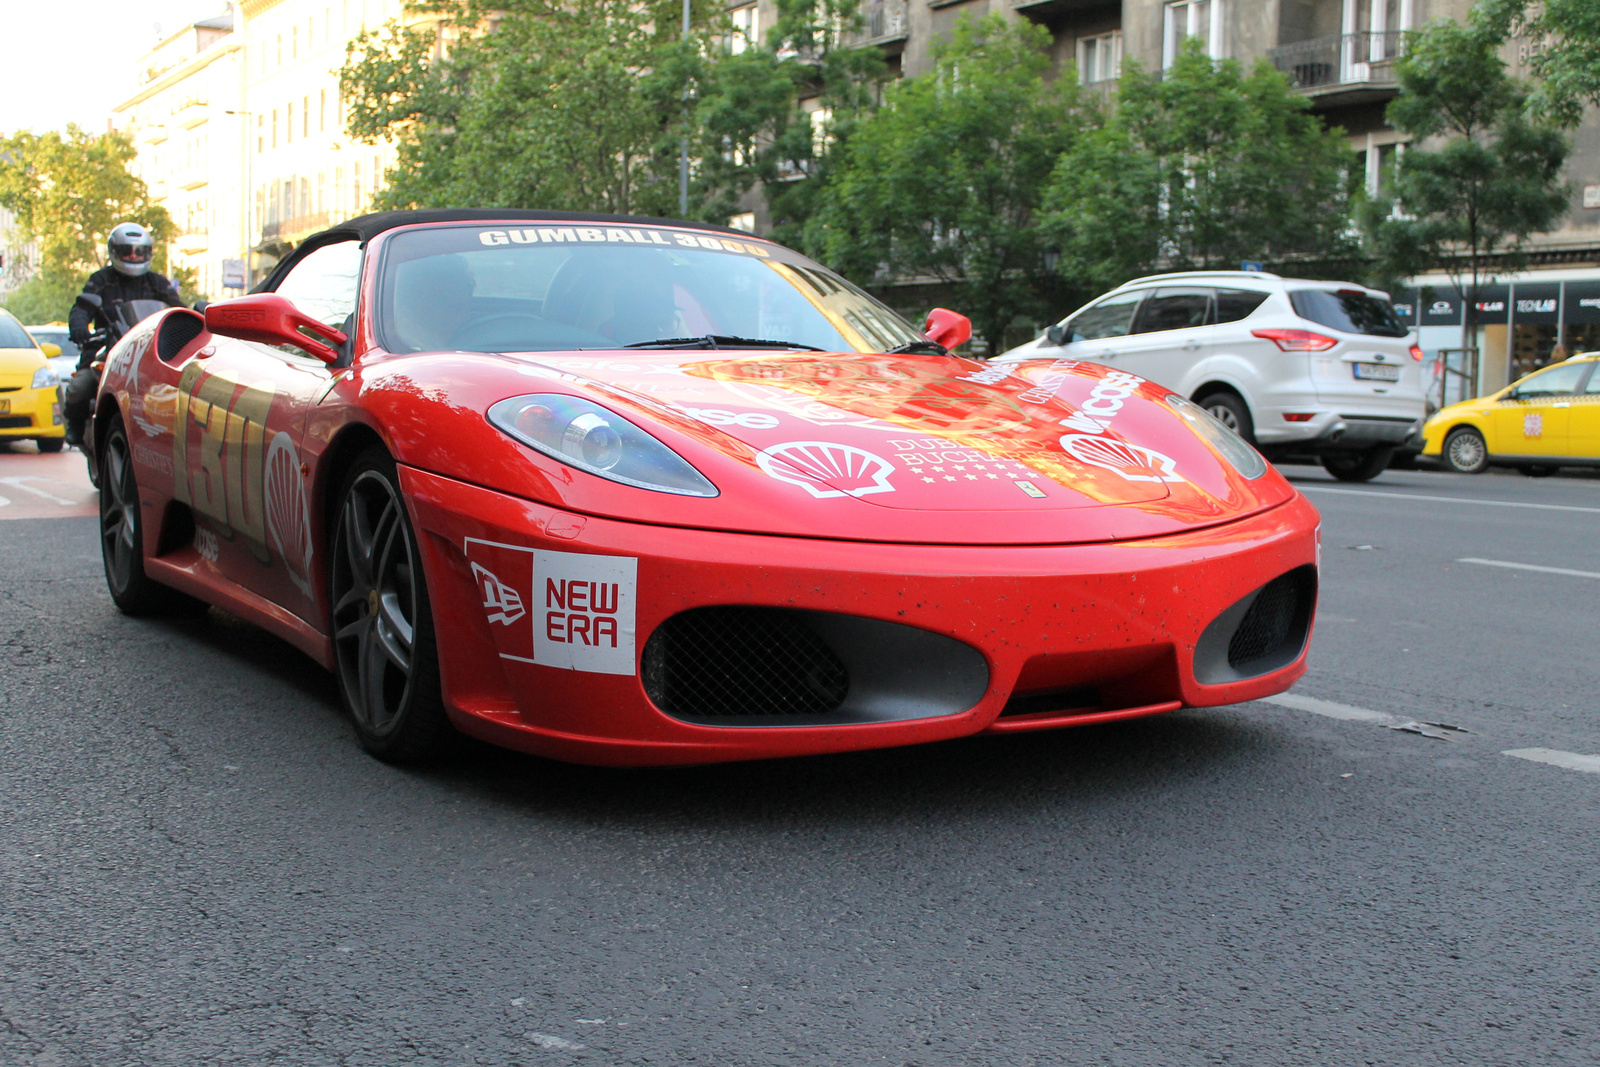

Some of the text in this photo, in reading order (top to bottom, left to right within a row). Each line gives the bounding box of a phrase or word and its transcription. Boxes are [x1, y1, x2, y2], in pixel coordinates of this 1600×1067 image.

[478, 227, 771, 258] GUMBALL 3000
[887, 438, 1046, 450] DUBLIN TO
[894, 450, 1081, 466] BUCHAREST
[546, 577, 619, 614] NEW
[546, 611, 618, 648] ERA
